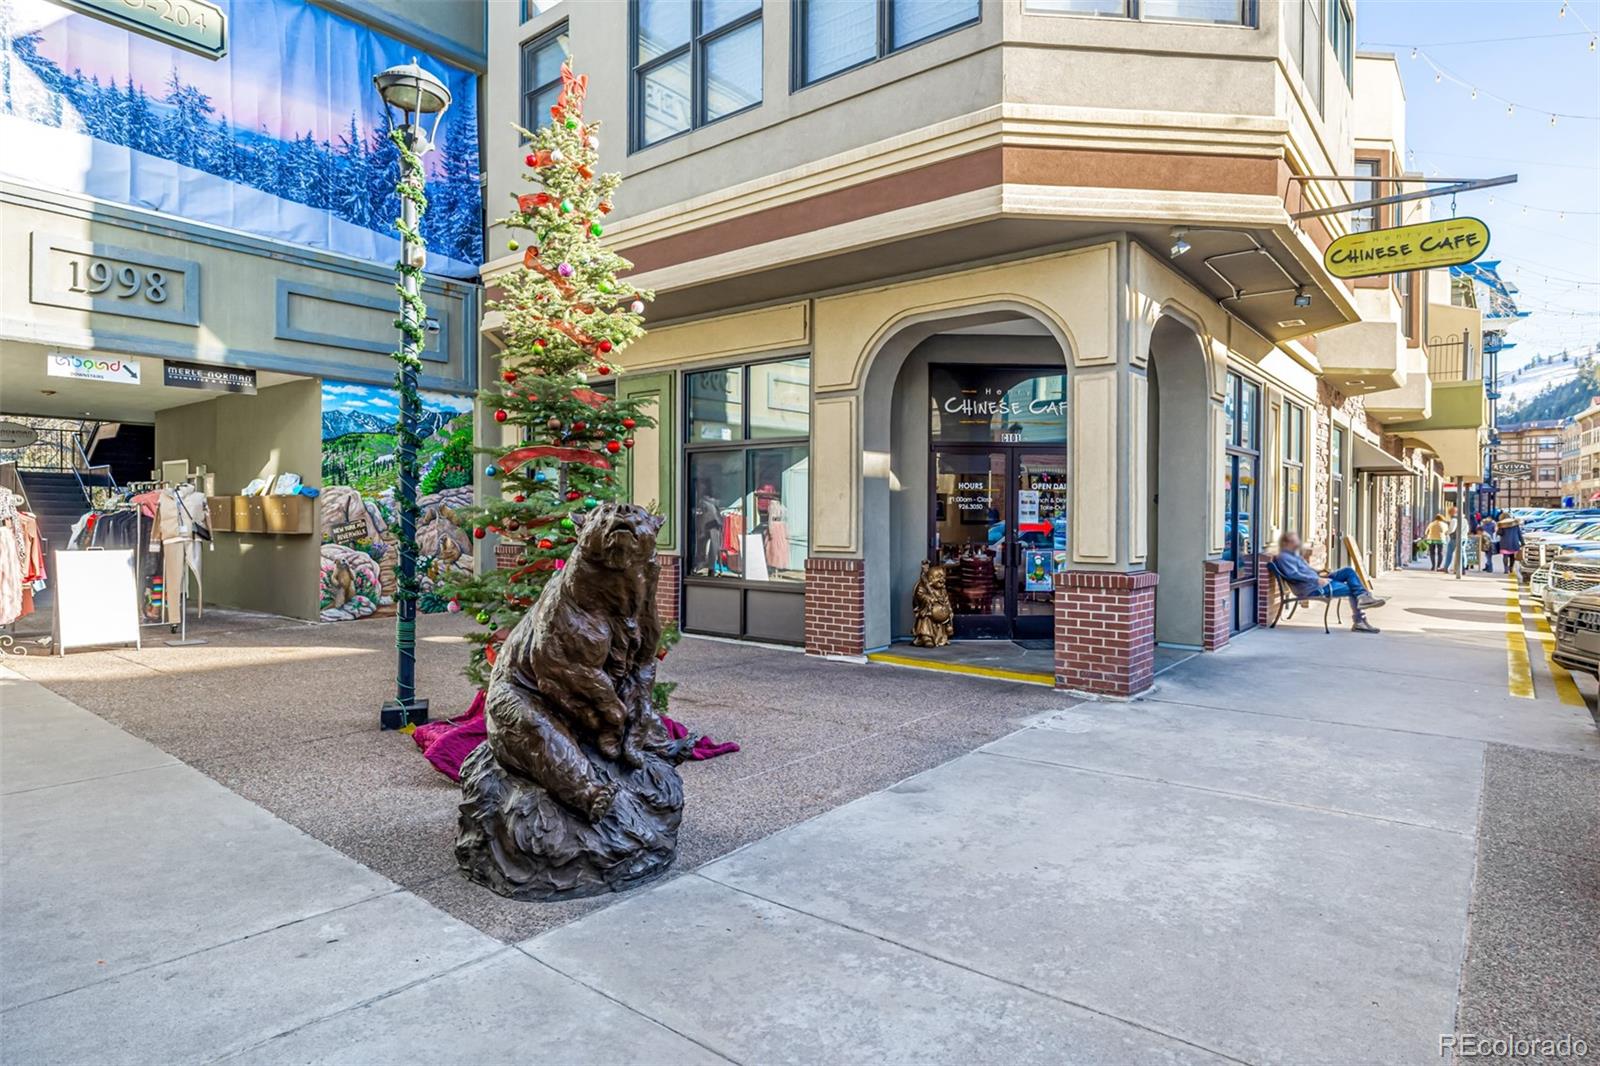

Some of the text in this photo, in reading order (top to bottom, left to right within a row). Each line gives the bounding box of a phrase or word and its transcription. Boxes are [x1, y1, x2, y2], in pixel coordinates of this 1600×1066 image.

[1330, 243, 1412, 264] CHINESE
[1420, 232, 1481, 252] CAFE
[68, 260, 168, 304] 1998
[168, 367, 203, 377] MERLE
[944, 397, 1068, 416] CHINESE CAF
[958, 482, 984, 490] HOURS
